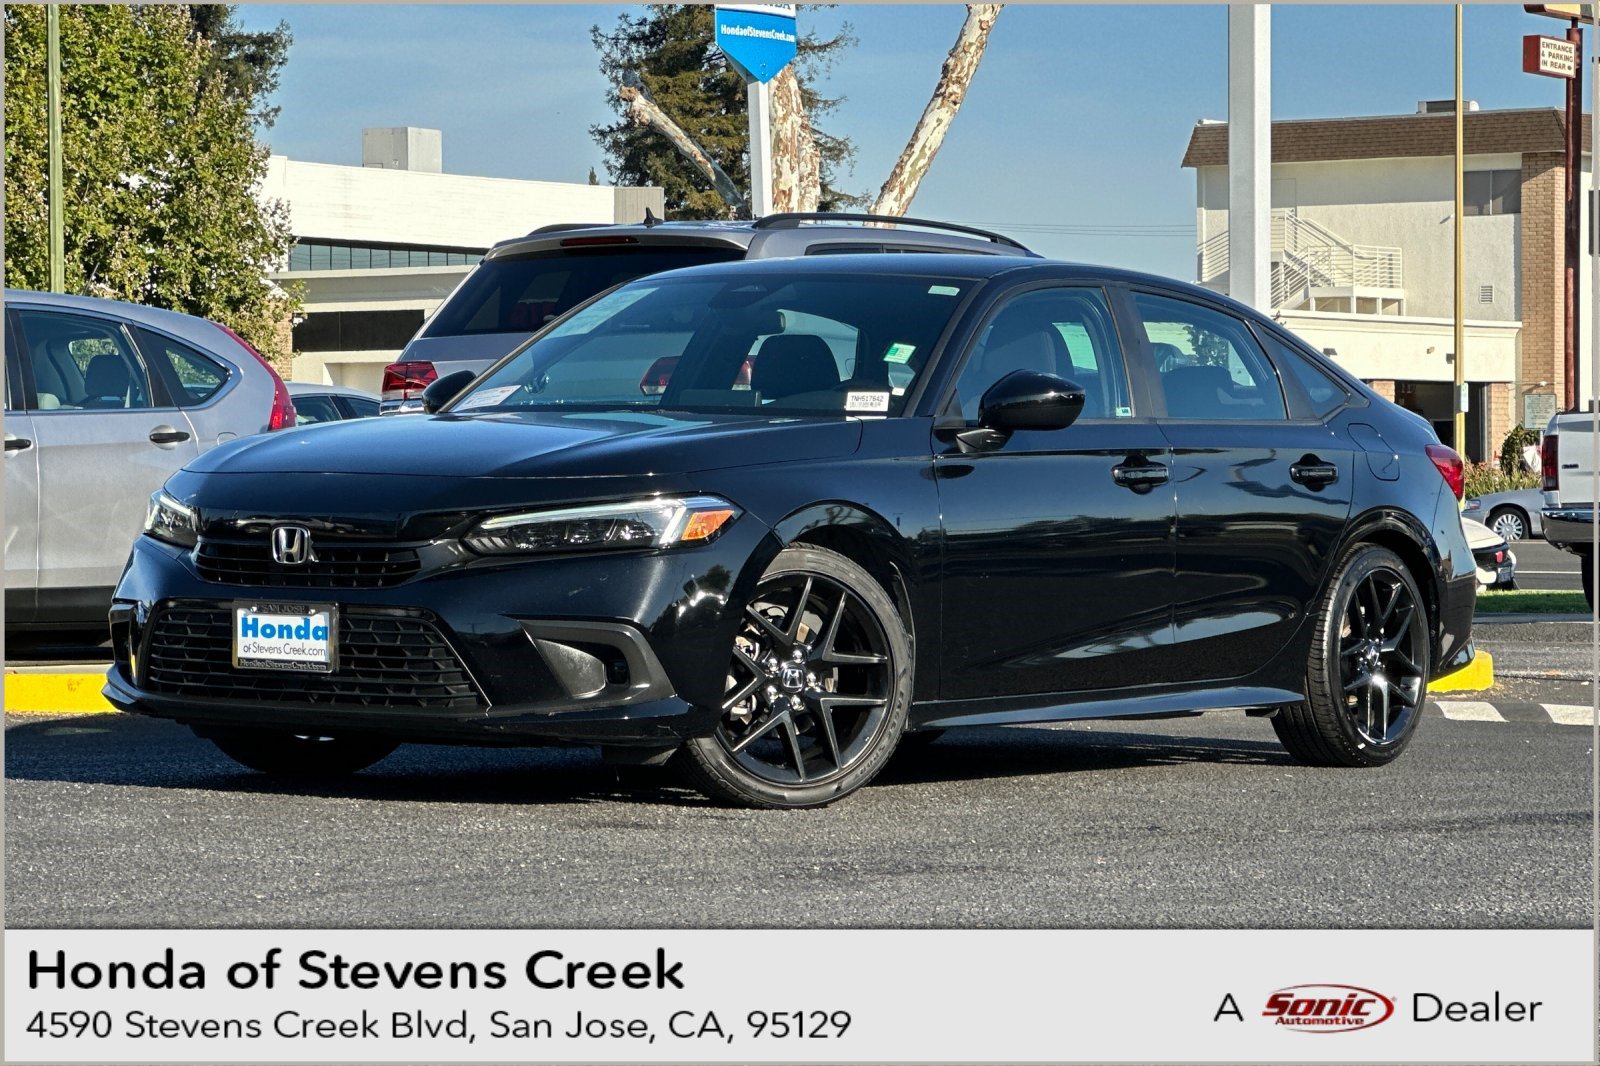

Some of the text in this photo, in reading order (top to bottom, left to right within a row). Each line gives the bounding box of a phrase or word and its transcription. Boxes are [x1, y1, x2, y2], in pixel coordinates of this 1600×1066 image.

[1541, 42, 1573, 53] ENTRANCE
[1548, 51, 1574, 63] PARKING
[1550, 62, 1566, 70] REAR
[241, 617, 328, 641] Honda
[243, 641, 326, 656] of Stevens Creek.com
